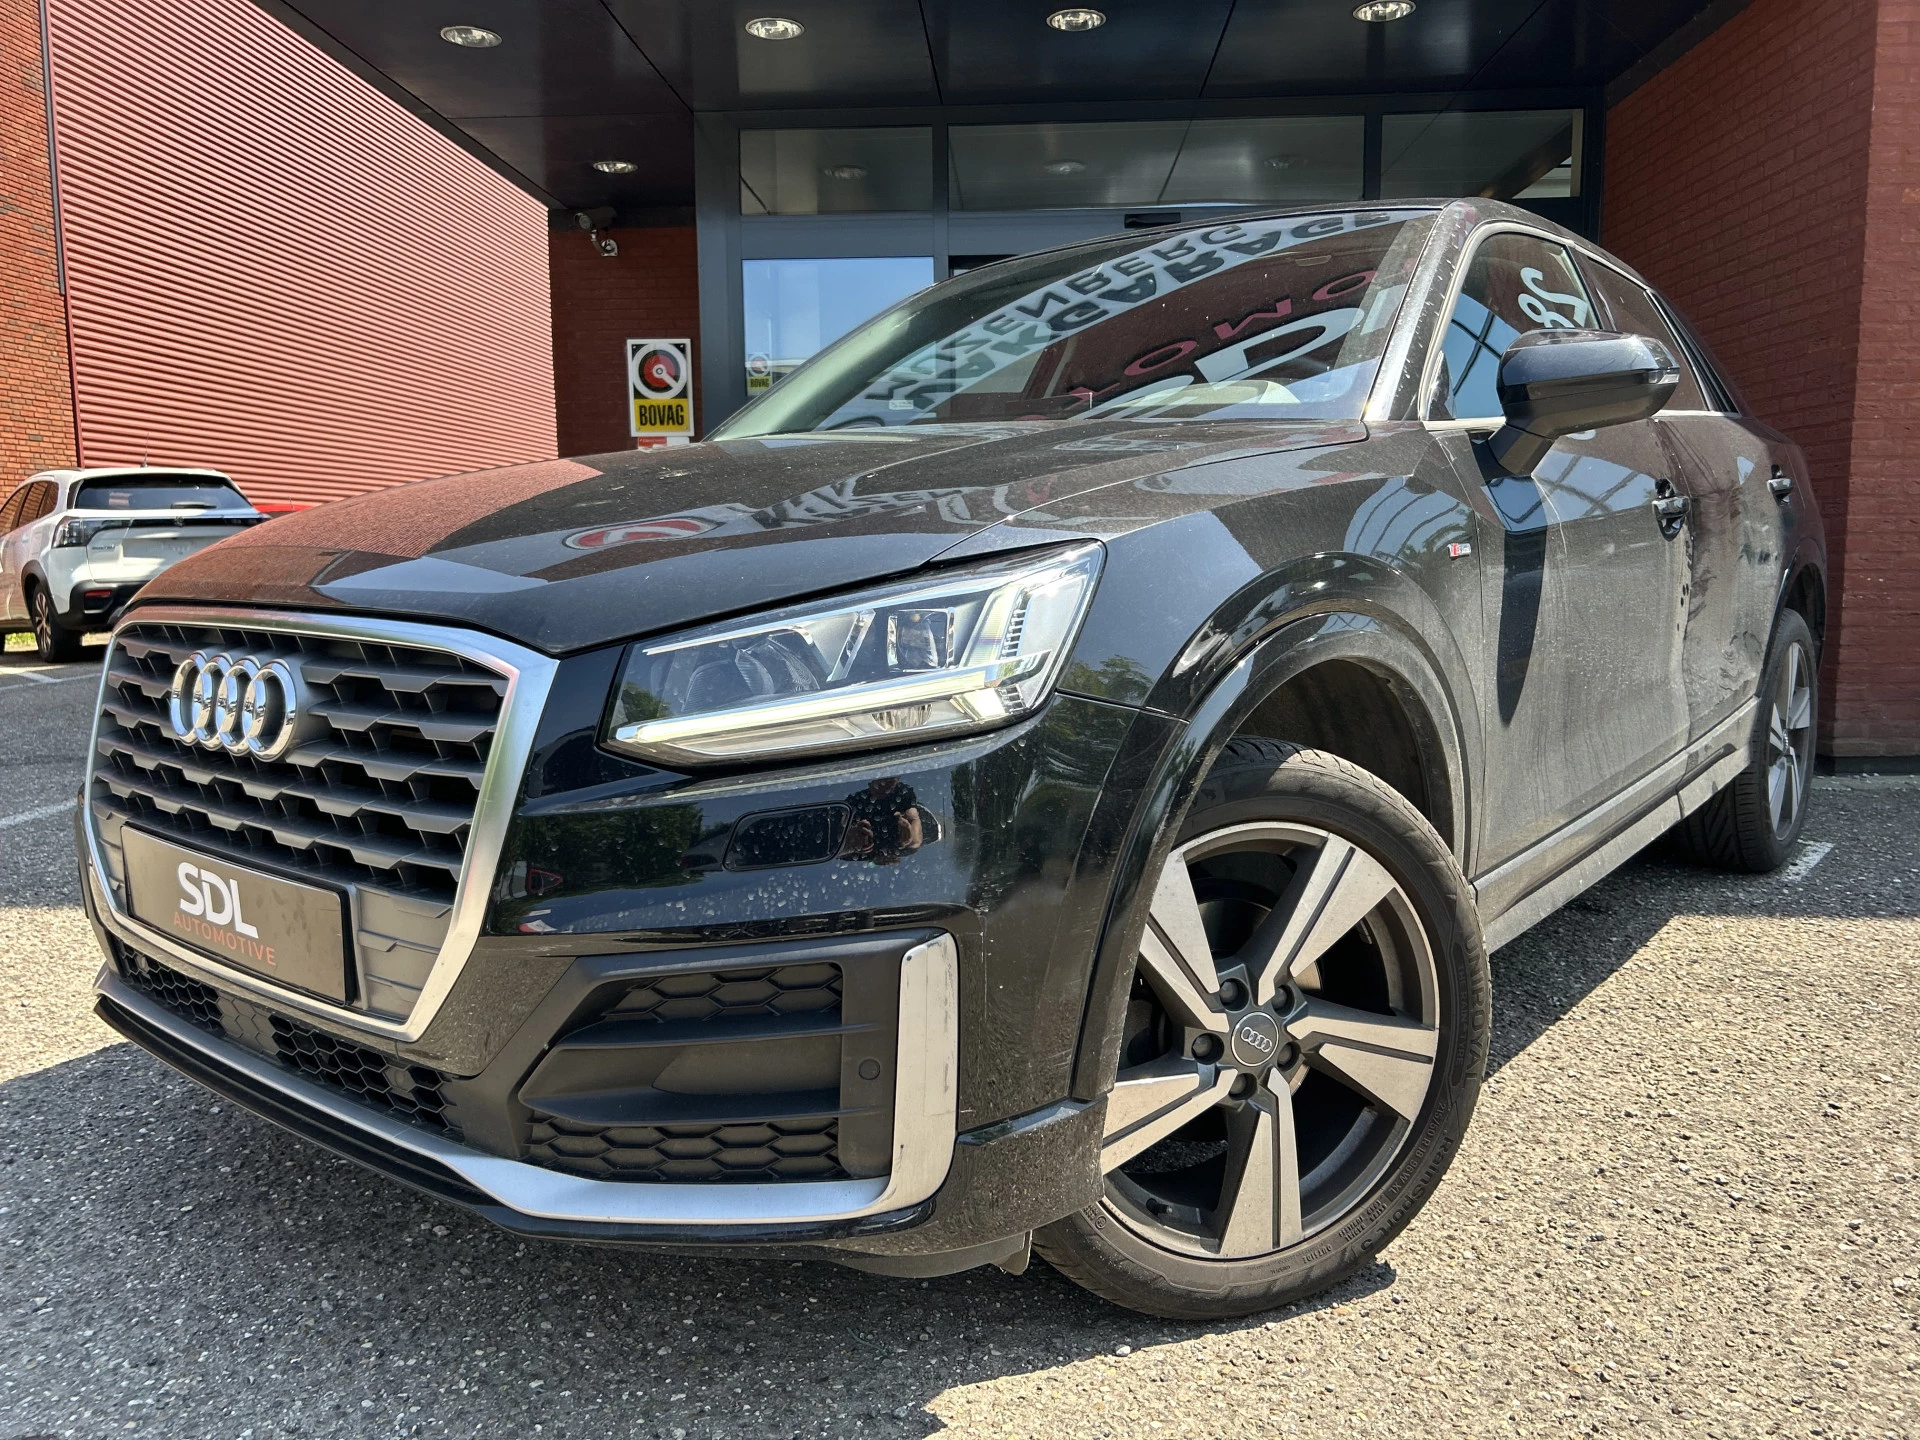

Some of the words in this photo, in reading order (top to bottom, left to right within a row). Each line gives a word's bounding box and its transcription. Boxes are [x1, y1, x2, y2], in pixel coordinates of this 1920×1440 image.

[749, 378, 770, 388] BOVAG
[639, 404, 685, 426] BOVAG
[177, 862, 259, 939] SDL
[174, 912, 275, 966] AUTOMOTIVE
[1461, 934, 1485, 1090] UNIROYAL
